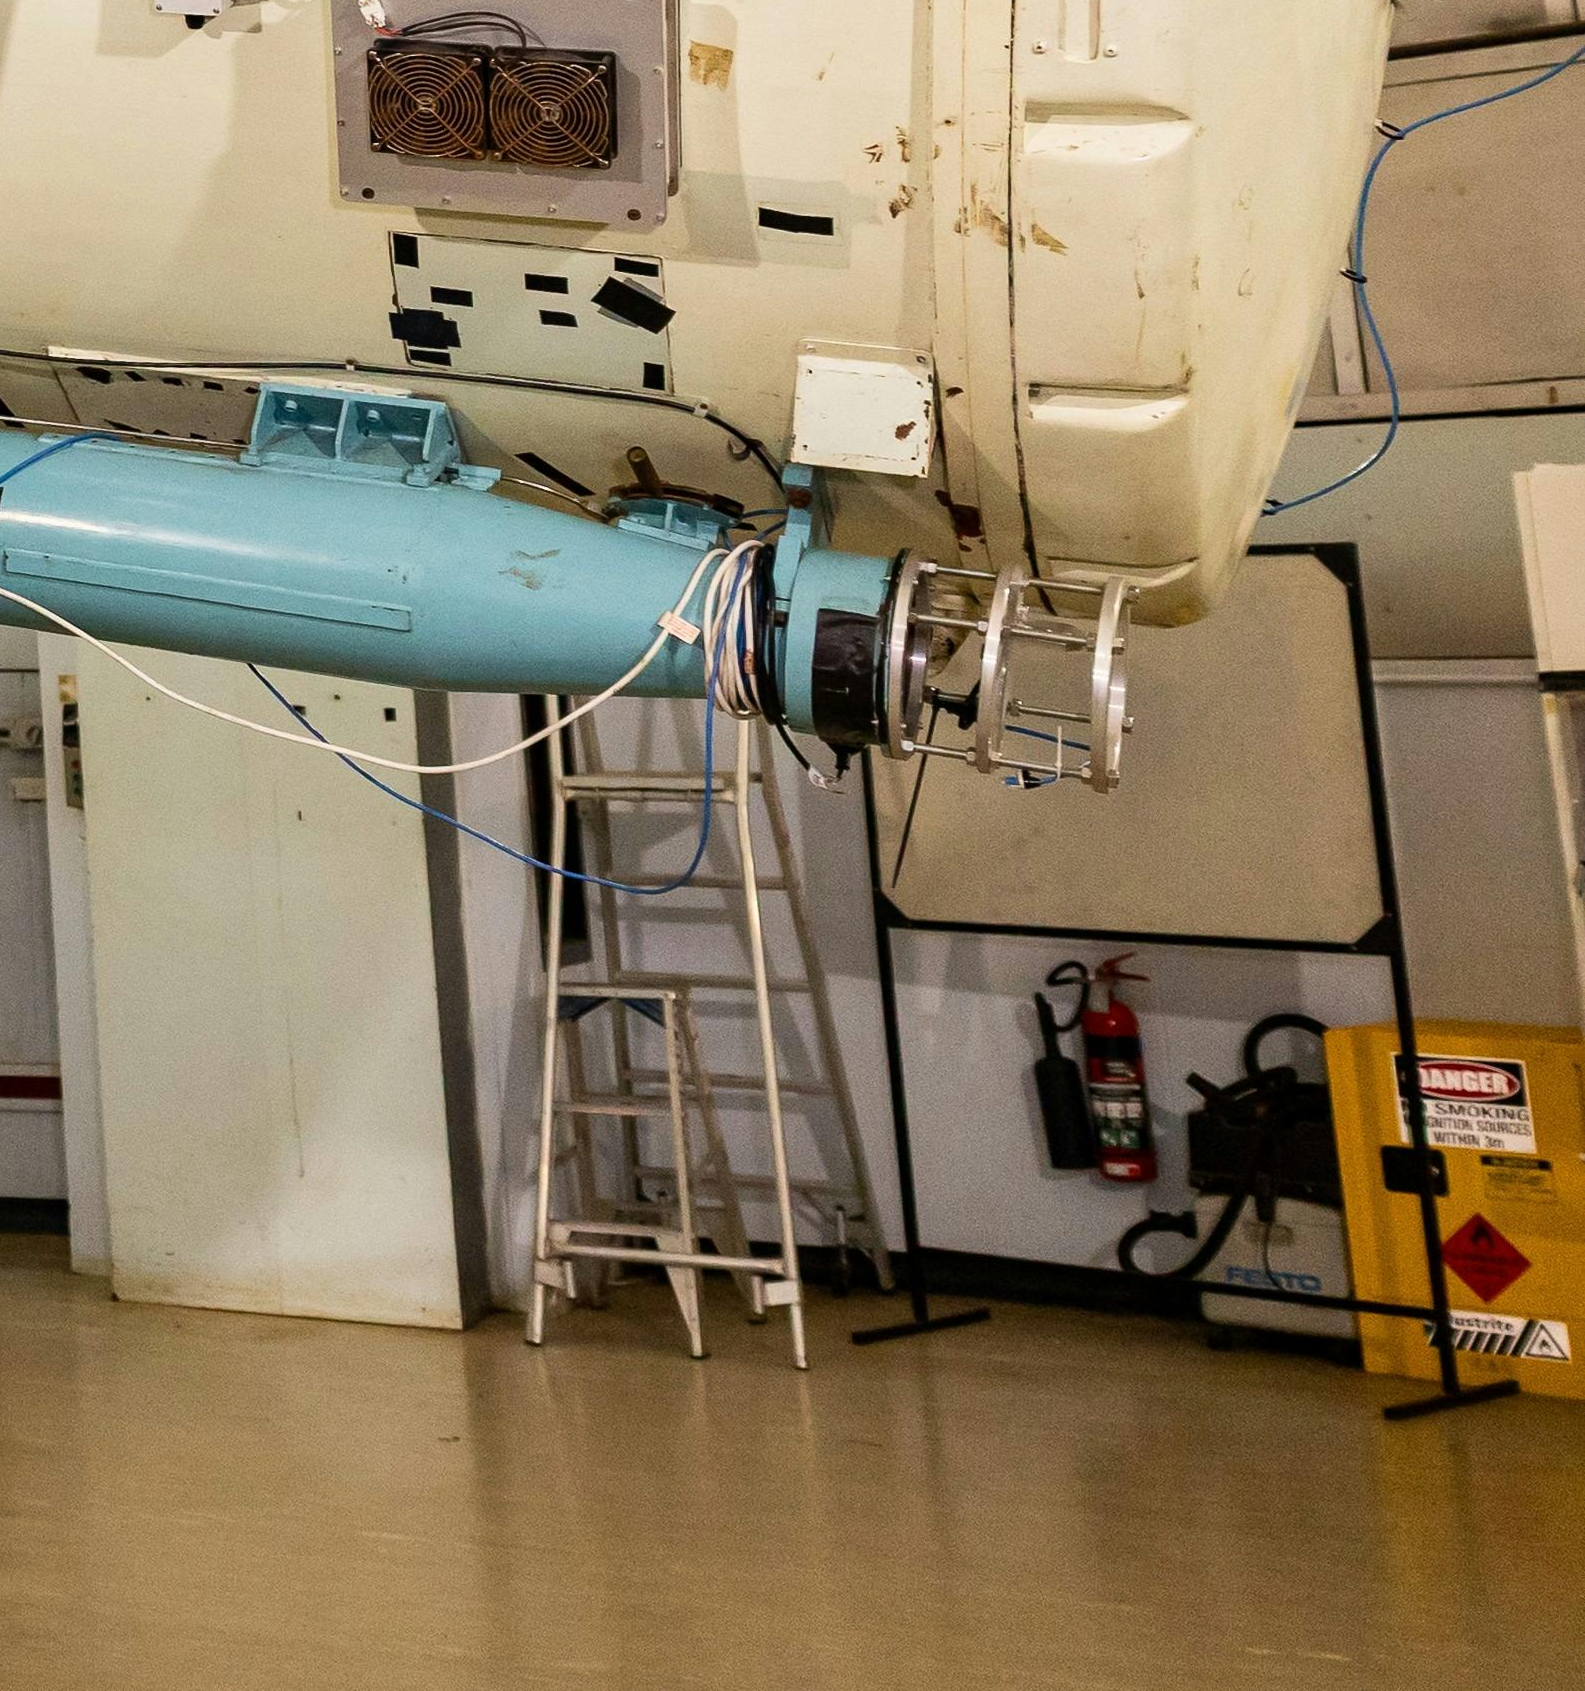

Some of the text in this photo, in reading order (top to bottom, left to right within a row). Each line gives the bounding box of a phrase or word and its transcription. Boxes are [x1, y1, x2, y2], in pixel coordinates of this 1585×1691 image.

[1434, 1102, 1529, 1121] SMOKING
[1476, 1120, 1533, 1136] SOURCES
[1433, 1131, 1480, 1148] WITHIN
[1451, 1316, 1514, 1333] ustrite
